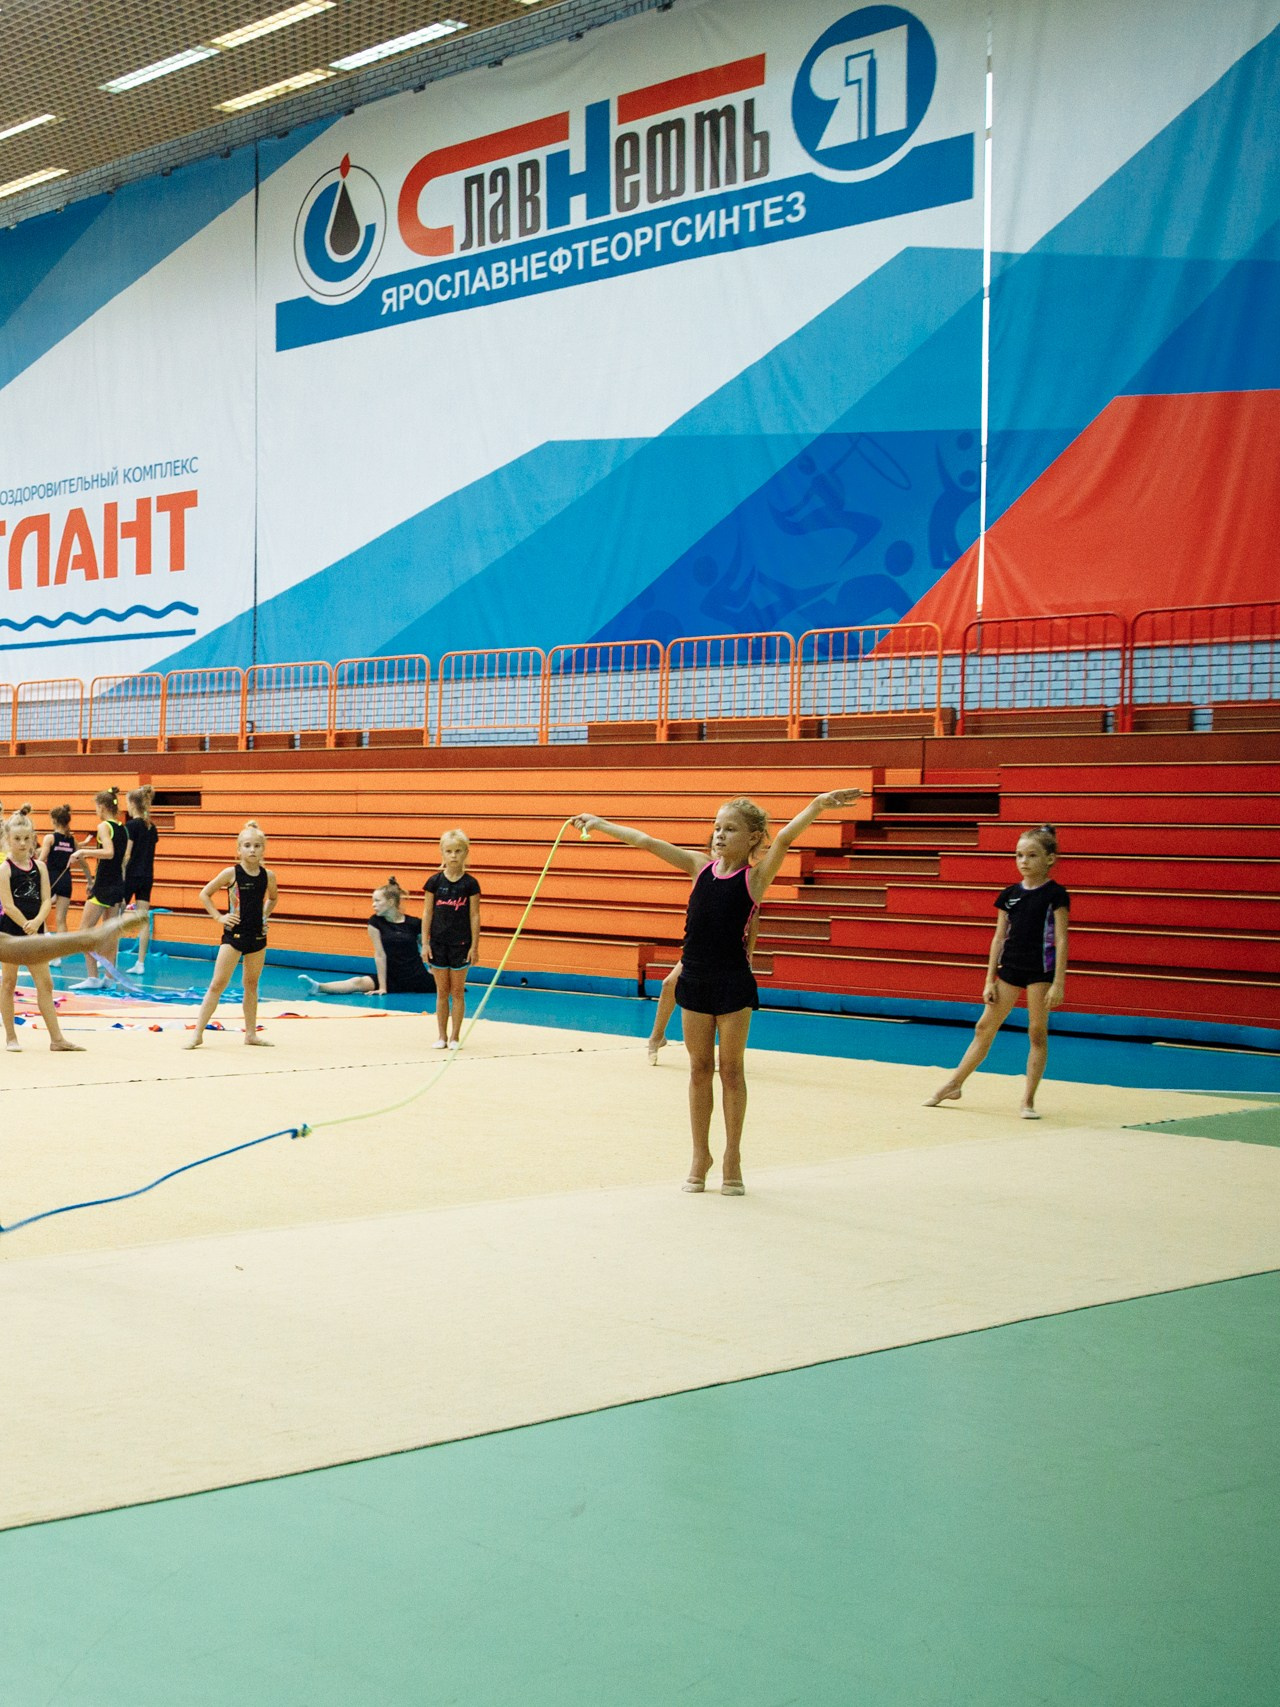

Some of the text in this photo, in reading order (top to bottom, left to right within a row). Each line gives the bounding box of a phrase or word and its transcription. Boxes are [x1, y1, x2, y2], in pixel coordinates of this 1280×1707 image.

[809, 24, 908, 151] Я
[398, 99, 770, 257] СлавНефть
[380, 191, 807, 316] ЯРОСЛАВНЕФТЕОРГСИНТЕЗ
[122, 456, 199, 485] КОМПЛЕКС
